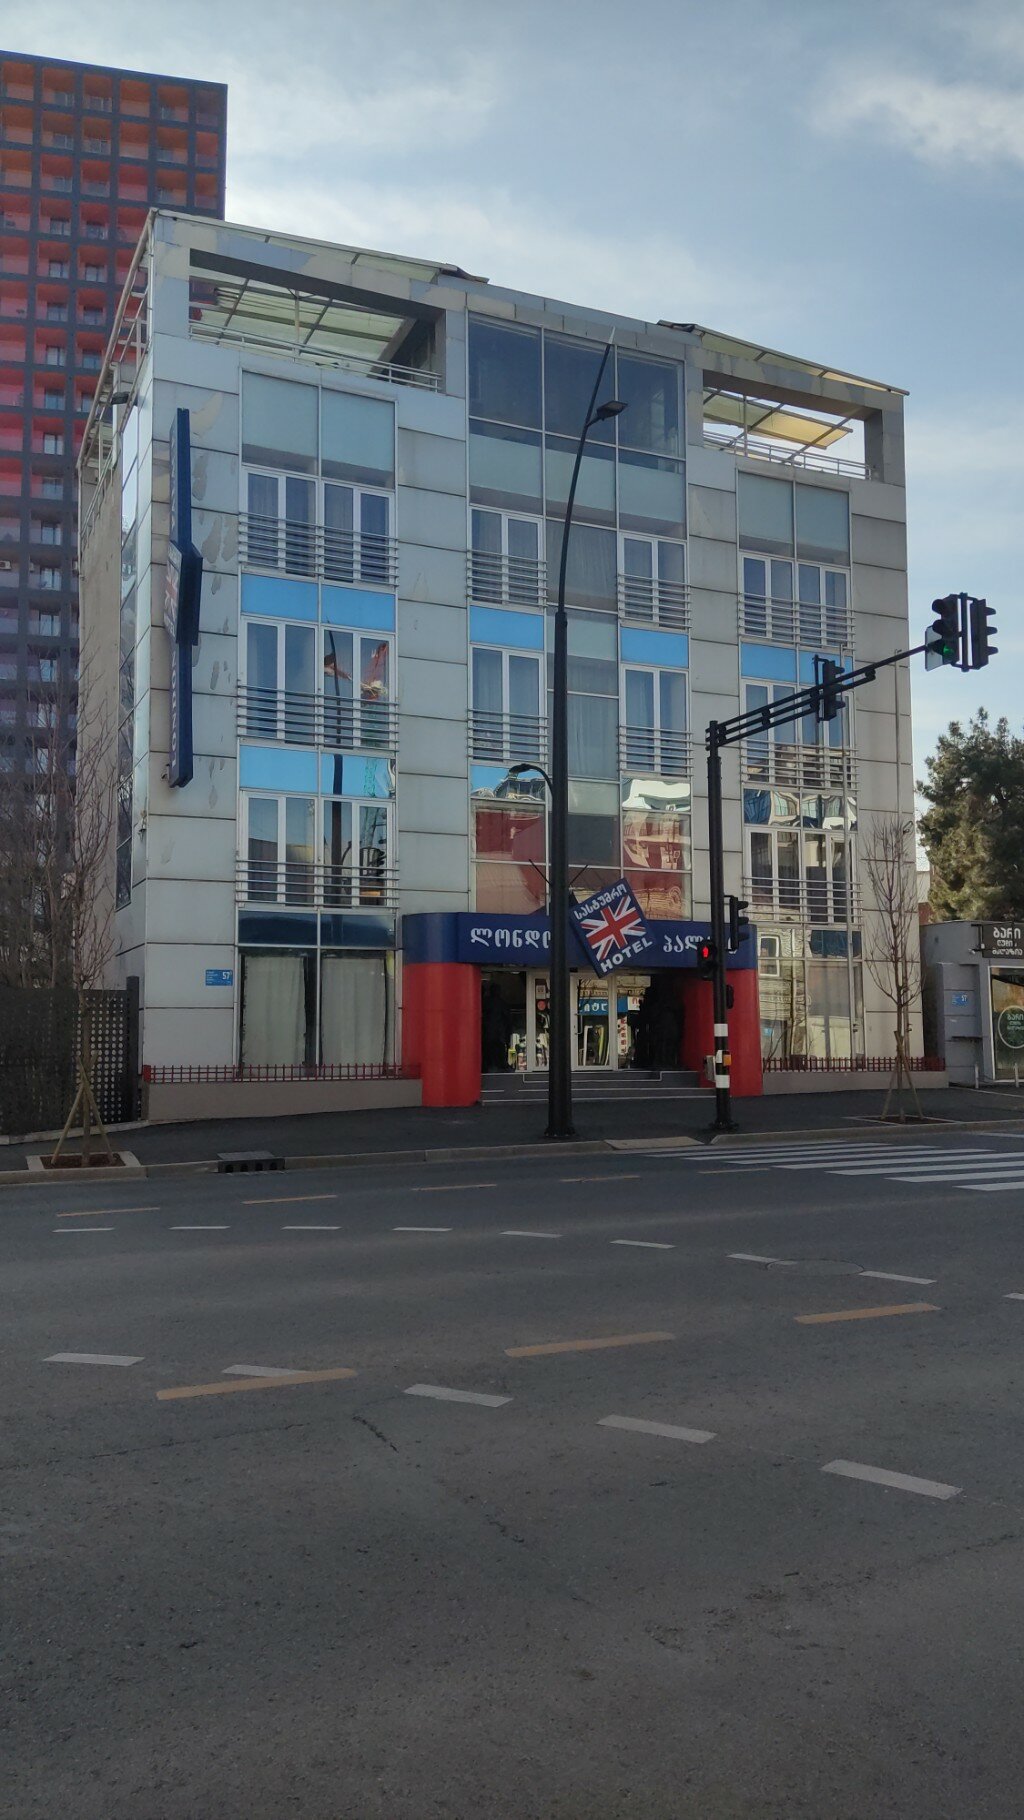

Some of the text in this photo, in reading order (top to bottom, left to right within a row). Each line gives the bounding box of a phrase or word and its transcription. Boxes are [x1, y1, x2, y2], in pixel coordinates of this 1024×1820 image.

[573, 883, 628, 920] სასტუმრო
[470, 927, 552, 949] ლონდო
[993, 927, 1021, 939] ბარი
[600, 937, 653, 973] HOTEL
